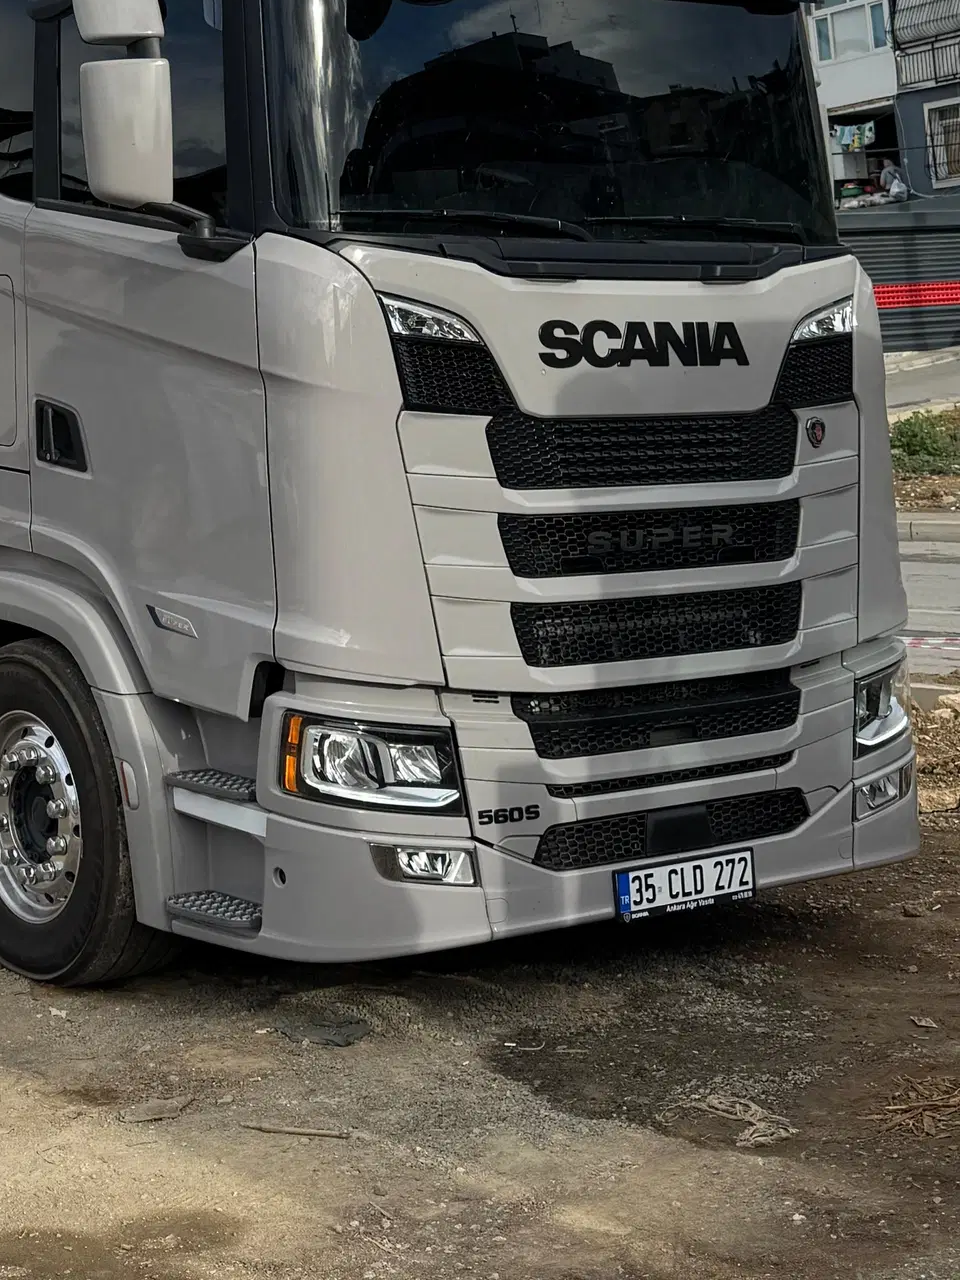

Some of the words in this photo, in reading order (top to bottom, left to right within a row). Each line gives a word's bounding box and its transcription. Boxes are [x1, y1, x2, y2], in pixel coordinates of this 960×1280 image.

[538, 320, 750, 368] SCANIA
[588, 524, 734, 554] SUPER
[478, 804, 540, 825] 560S
[631, 873, 656, 906] 35
[668, 864, 705, 899] CLD
[713, 856, 749, 891] 272
[620, 895, 630, 905] TR
[666, 903, 686, 913] Ankara
